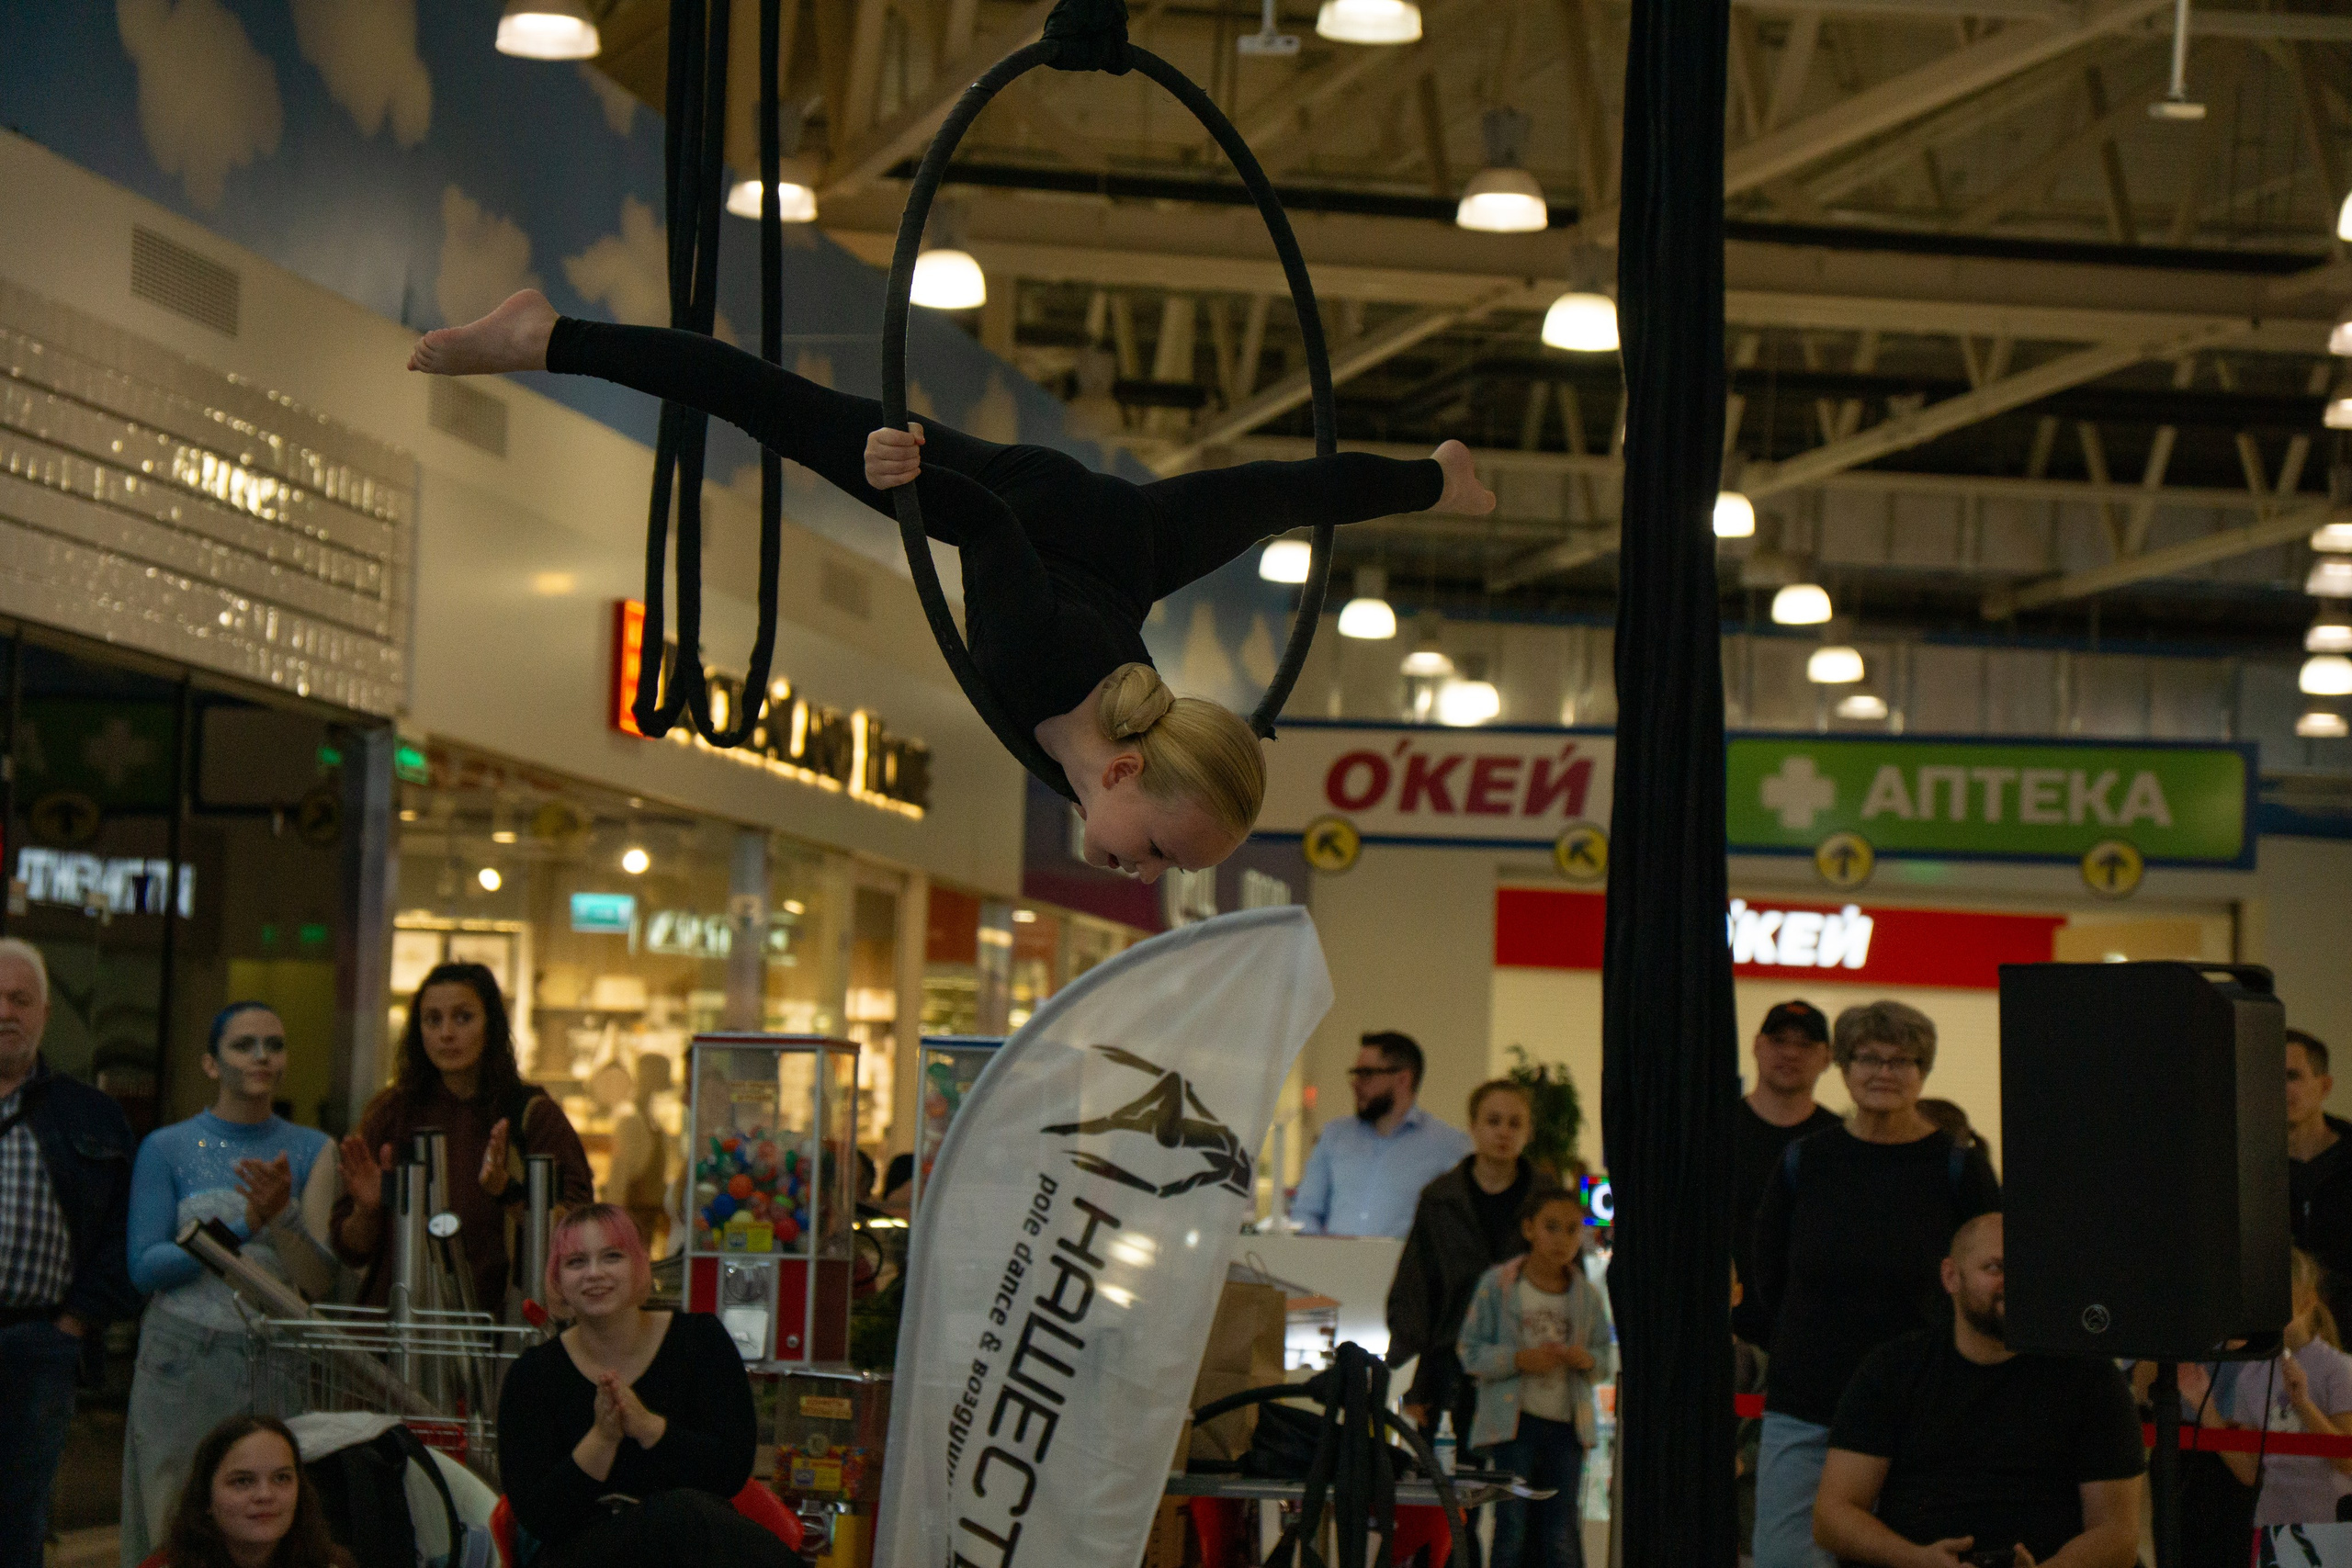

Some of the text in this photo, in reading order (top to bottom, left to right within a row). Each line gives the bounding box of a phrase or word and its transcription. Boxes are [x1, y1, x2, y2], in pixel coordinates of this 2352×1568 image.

[1860, 763, 2172, 827] АПТЕКА
[1726, 897, 1874, 969] 'КЕЙ
[1023, 1172, 1058, 1236] pole
[989, 1242, 1033, 1326] dance
